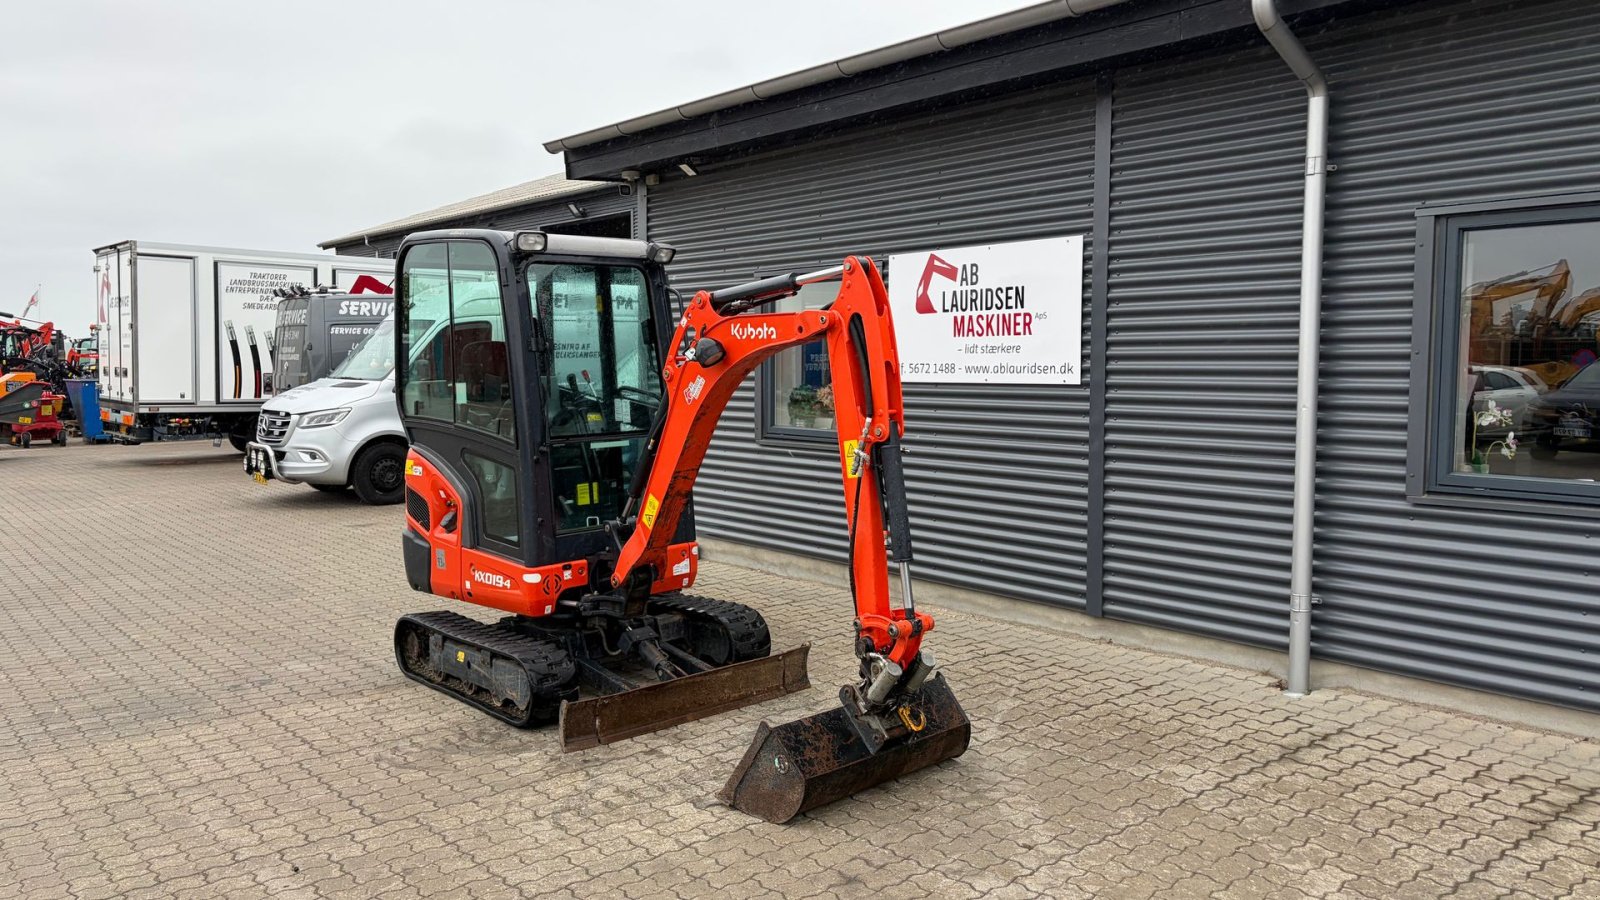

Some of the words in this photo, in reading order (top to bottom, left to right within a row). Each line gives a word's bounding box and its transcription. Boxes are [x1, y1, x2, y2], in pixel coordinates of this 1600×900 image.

[249, 272, 288, 281] TRAKTORER
[959, 263, 979, 287] AB
[225, 286, 274, 295] ENTREPRENØR
[942, 285, 1025, 313] LAURIDSEN
[242, 302, 278, 311] SMEDEARB
[339, 300, 395, 316] SERVIC
[330, 327, 362, 335] SERVICE
[731, 323, 777, 340] Kubota
[953, 312, 1033, 338] MASKINER
[1034, 312, 1048, 320] ApS
[964, 344, 979, 354] lidt
[980, 343, 1022, 355] stærkere
[909, 363, 931, 375] 5672
[933, 363, 956, 375] 1488
[964, 362, 1074, 375] www.ablauridsen.dk
[474, 569, 511, 590] KX019-4
